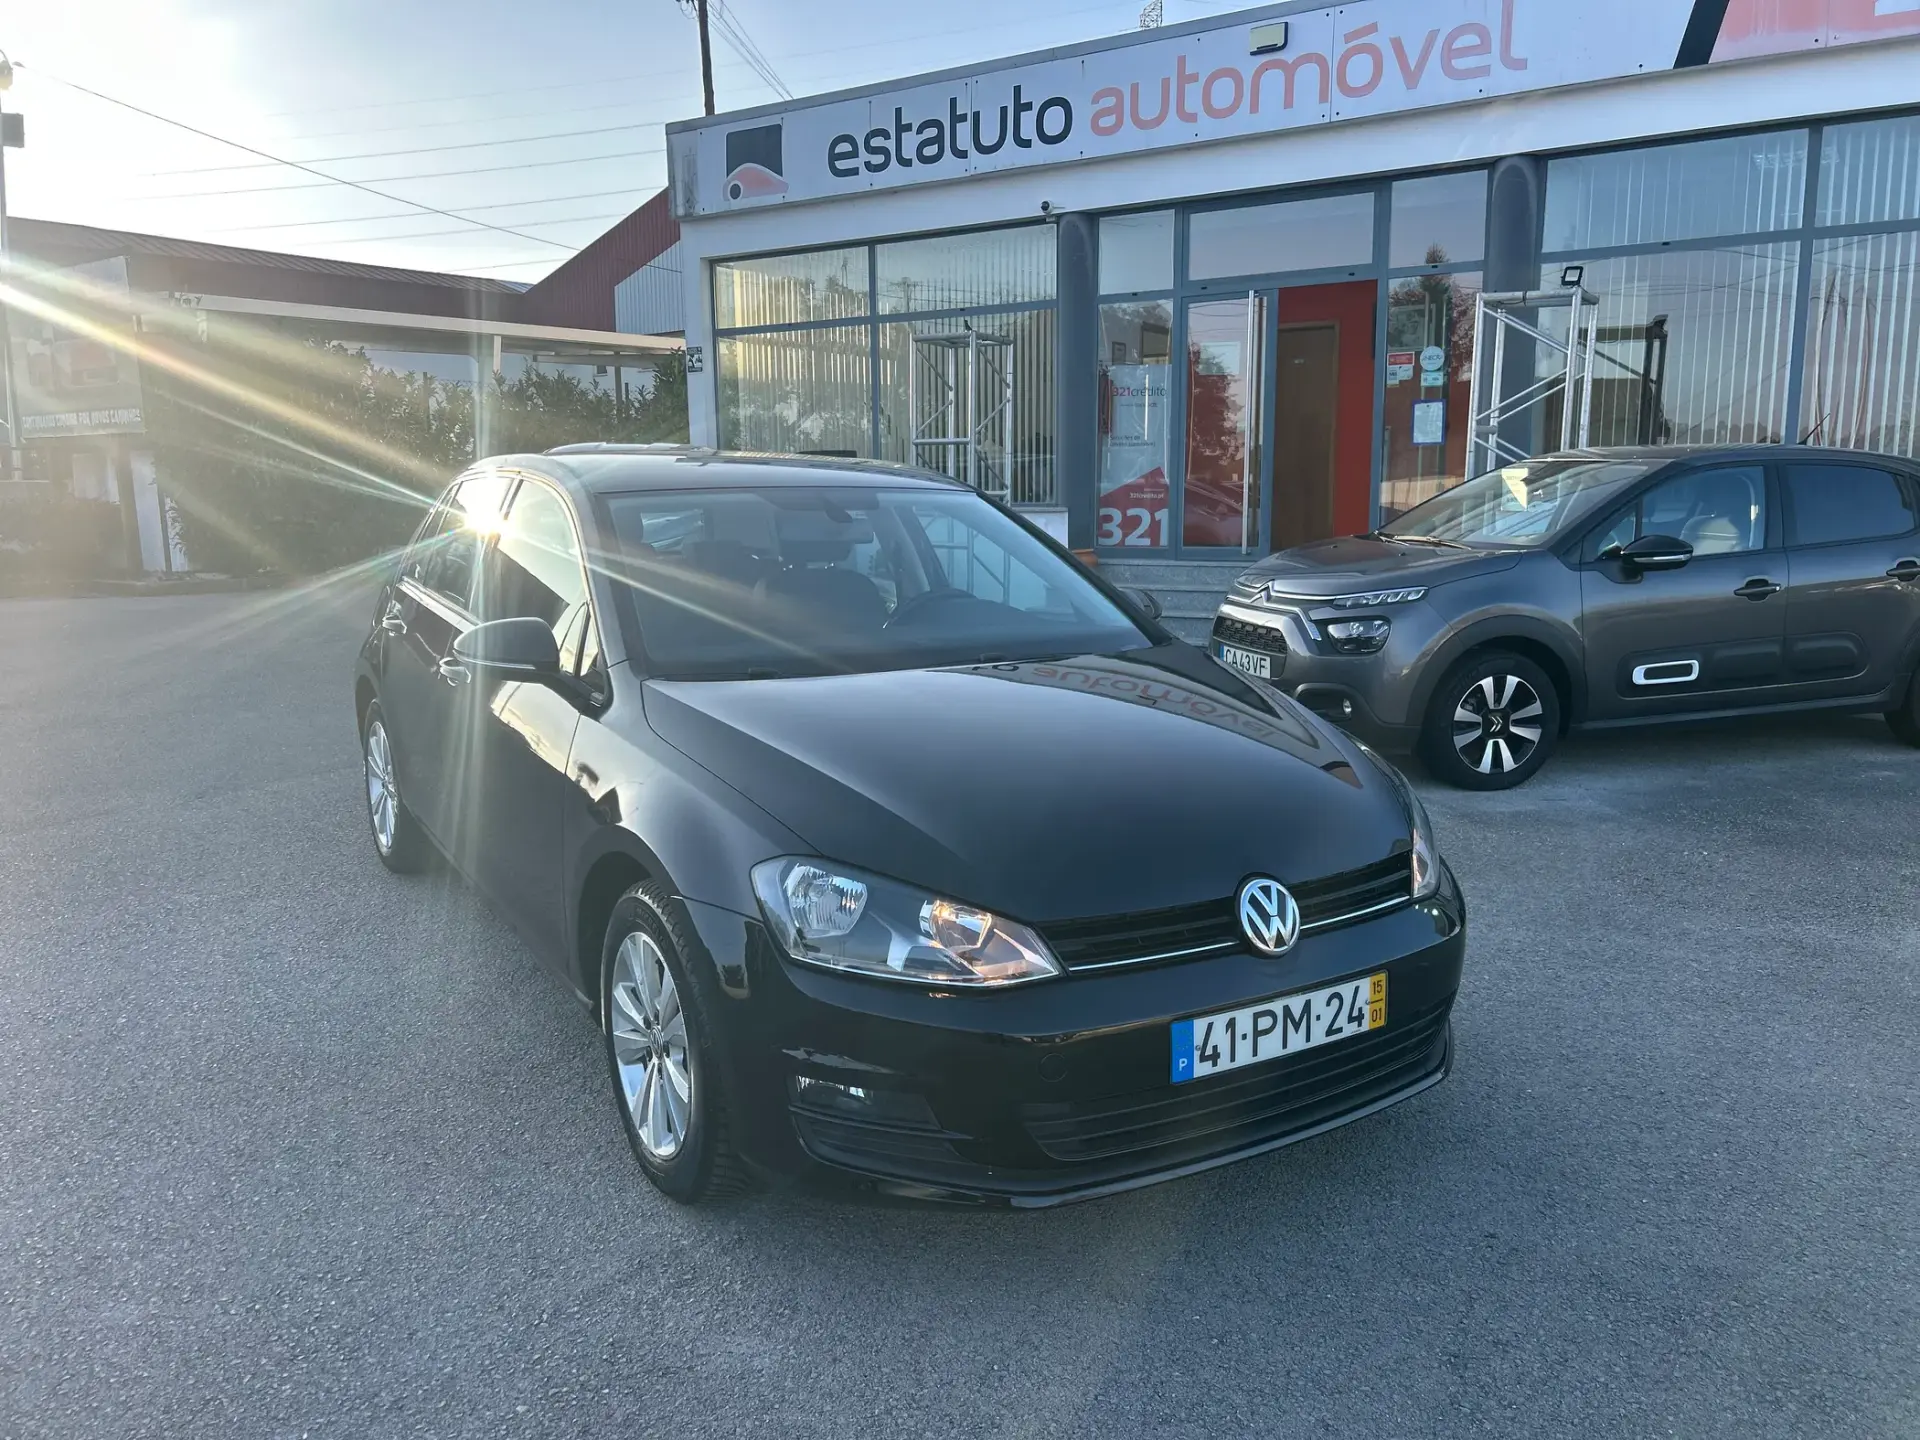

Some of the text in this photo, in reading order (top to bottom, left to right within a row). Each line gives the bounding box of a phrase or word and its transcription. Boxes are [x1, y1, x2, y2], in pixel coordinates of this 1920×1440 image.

[827, 0, 1528, 179] estatuto automóvel
[1097, 507, 1169, 546] 321
[1372, 979, 1383, 996] 15
[1371, 1007, 1382, 1023] 01
[1178, 1058, 1188, 1071] P
